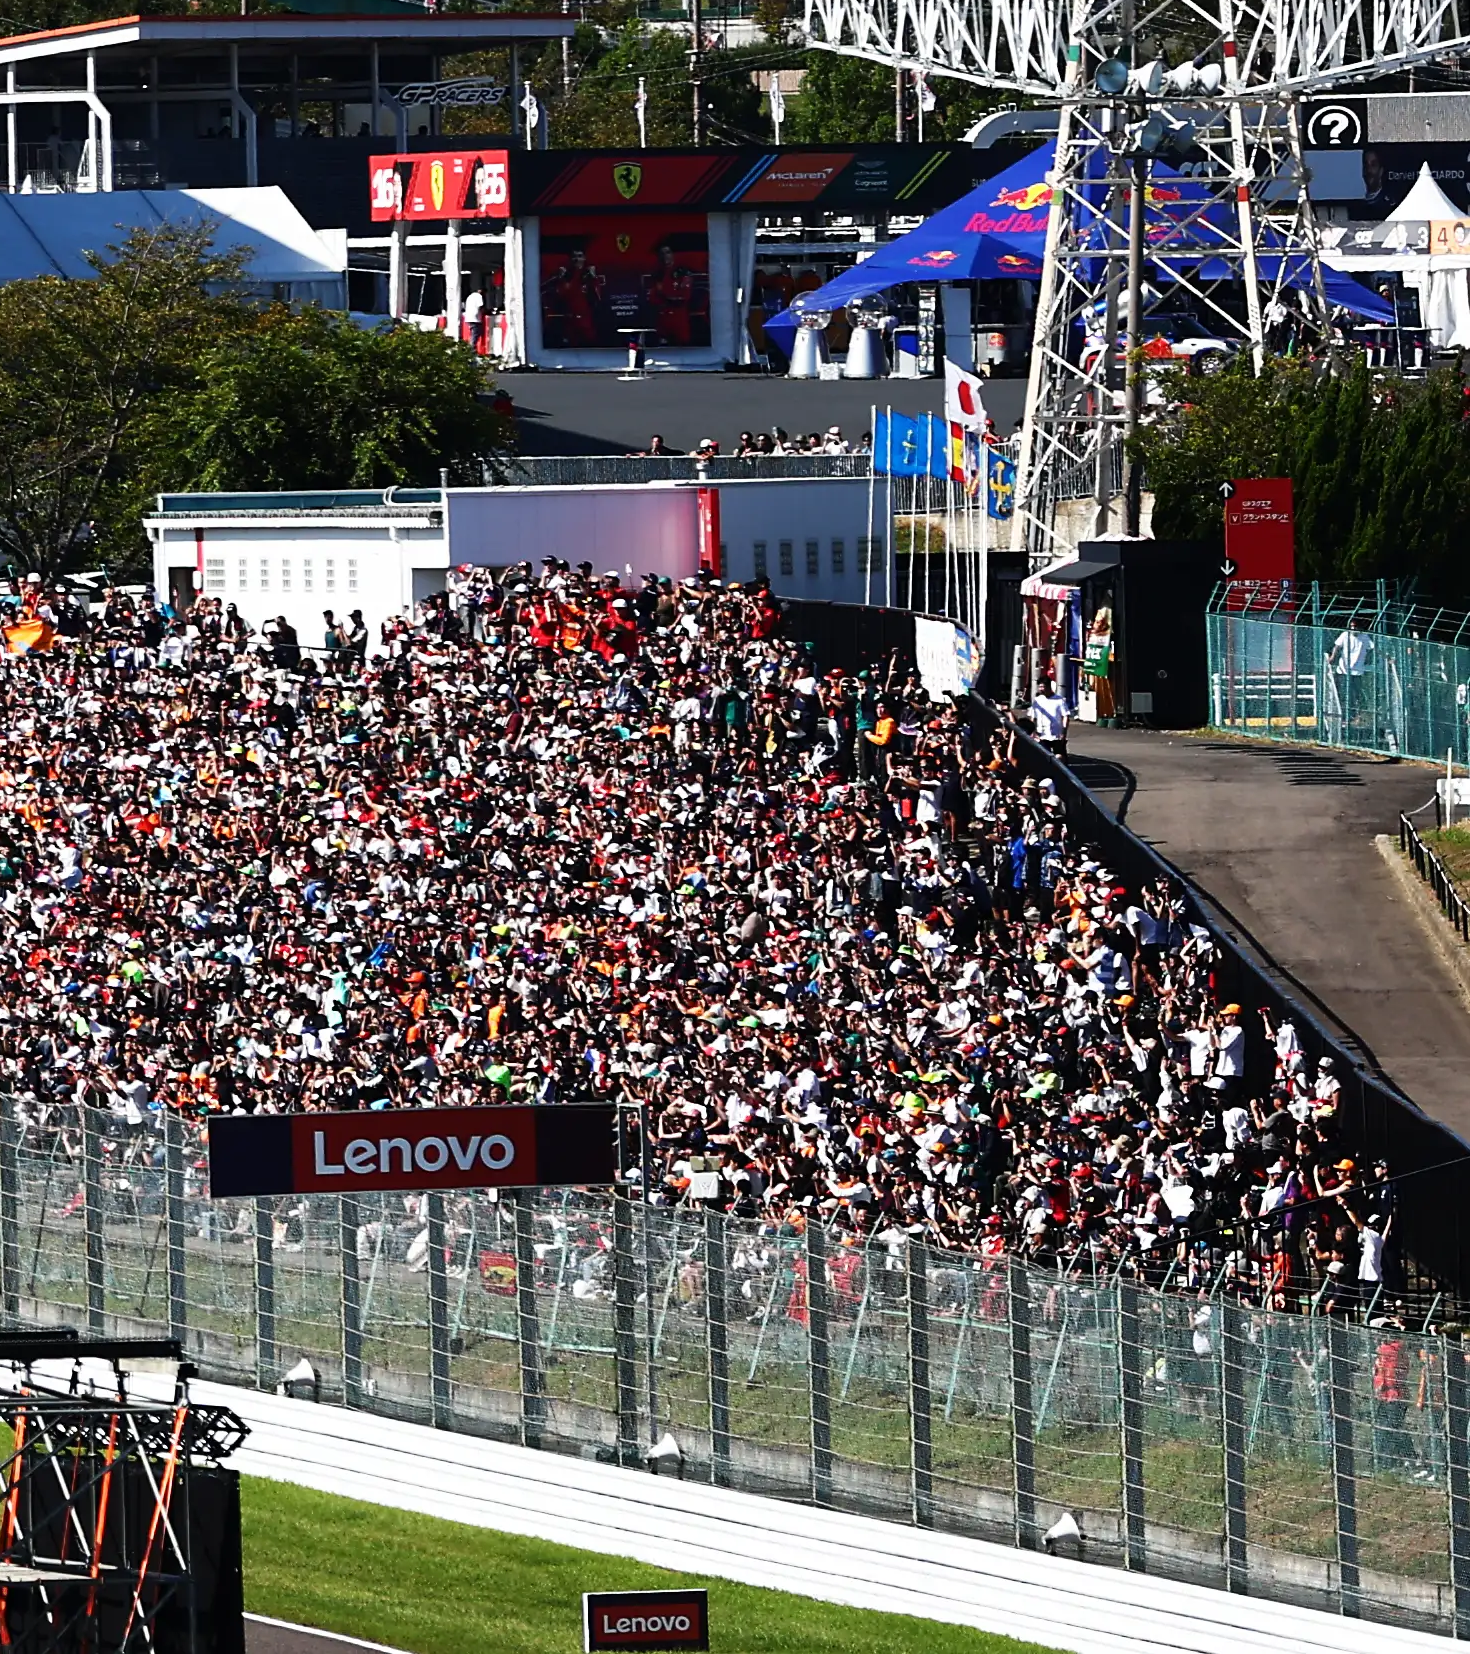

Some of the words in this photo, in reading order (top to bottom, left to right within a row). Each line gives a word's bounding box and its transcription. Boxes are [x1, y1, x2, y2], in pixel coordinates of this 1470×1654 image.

[1387, 170, 1415, 180] Daniel
[372, 169, 394, 208] 16
[964, 213, 1008, 232] Red
[1009, 213, 1049, 232] Bul
[314, 1130, 515, 1175] Lenovo
[603, 1614, 690, 1634] Lenovo
